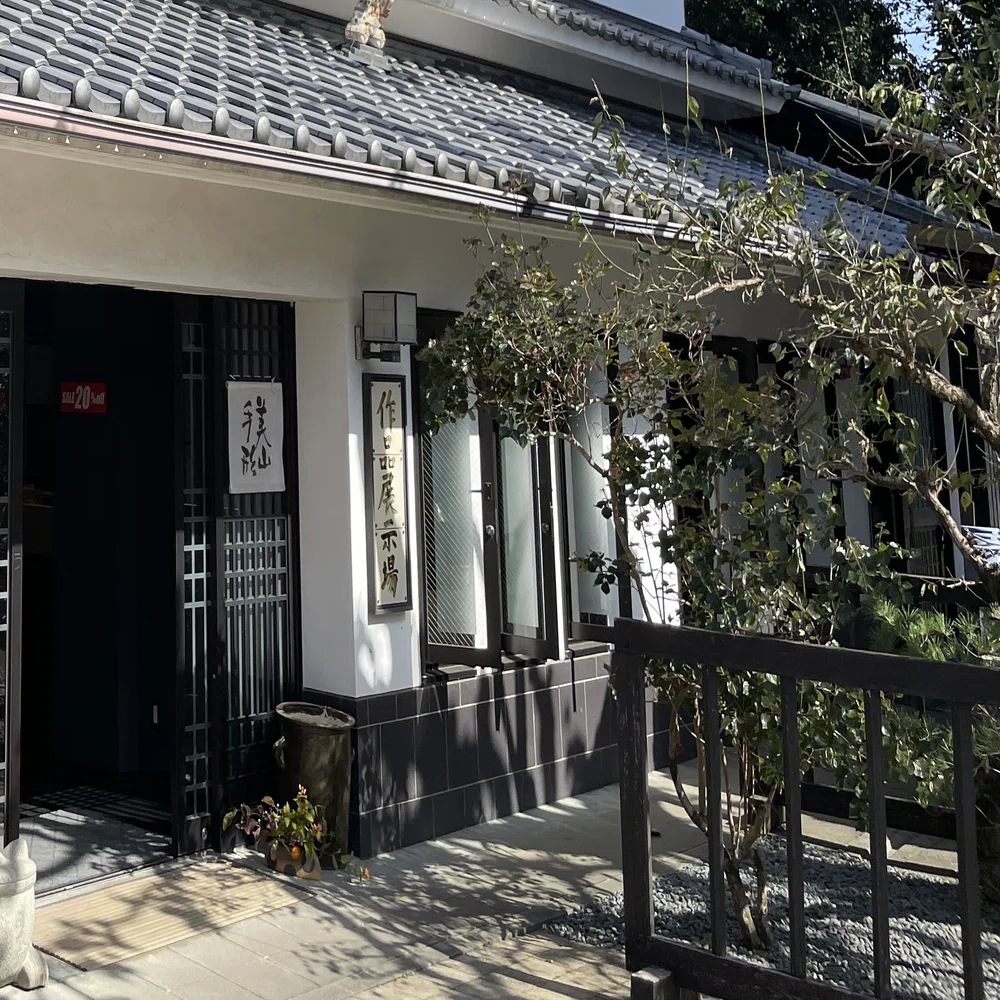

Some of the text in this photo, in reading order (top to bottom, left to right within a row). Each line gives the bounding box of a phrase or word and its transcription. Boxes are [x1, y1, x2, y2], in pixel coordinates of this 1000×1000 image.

[61, 391, 75, 404] SALE
[376, 389, 400, 598] 作品展示場
